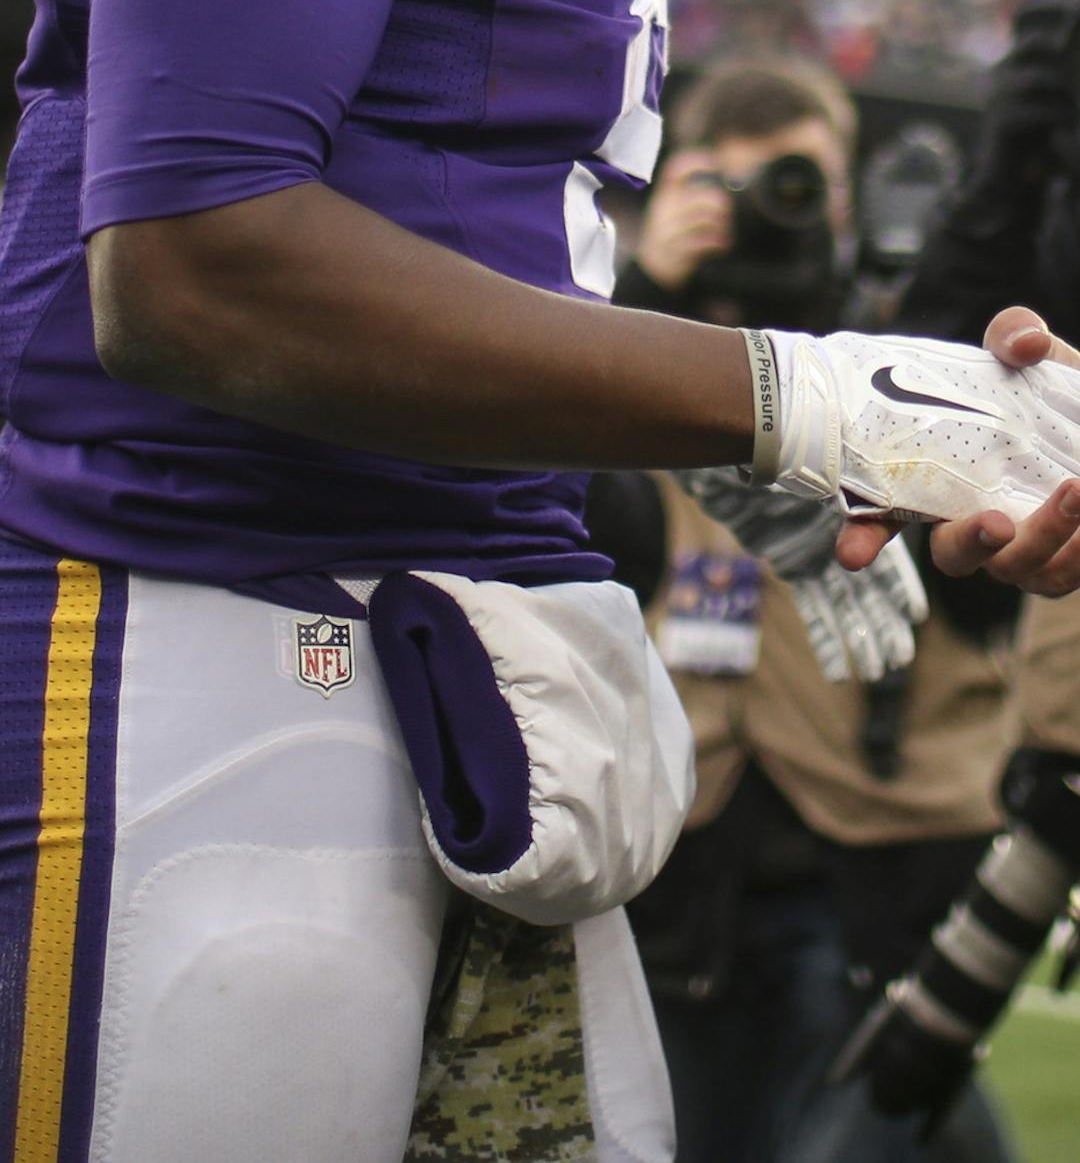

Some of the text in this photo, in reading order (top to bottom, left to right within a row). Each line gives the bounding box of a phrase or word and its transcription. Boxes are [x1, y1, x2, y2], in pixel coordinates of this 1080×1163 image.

[749, 331, 774, 432] ajor Pressure
[303, 648, 348, 683] NFL
